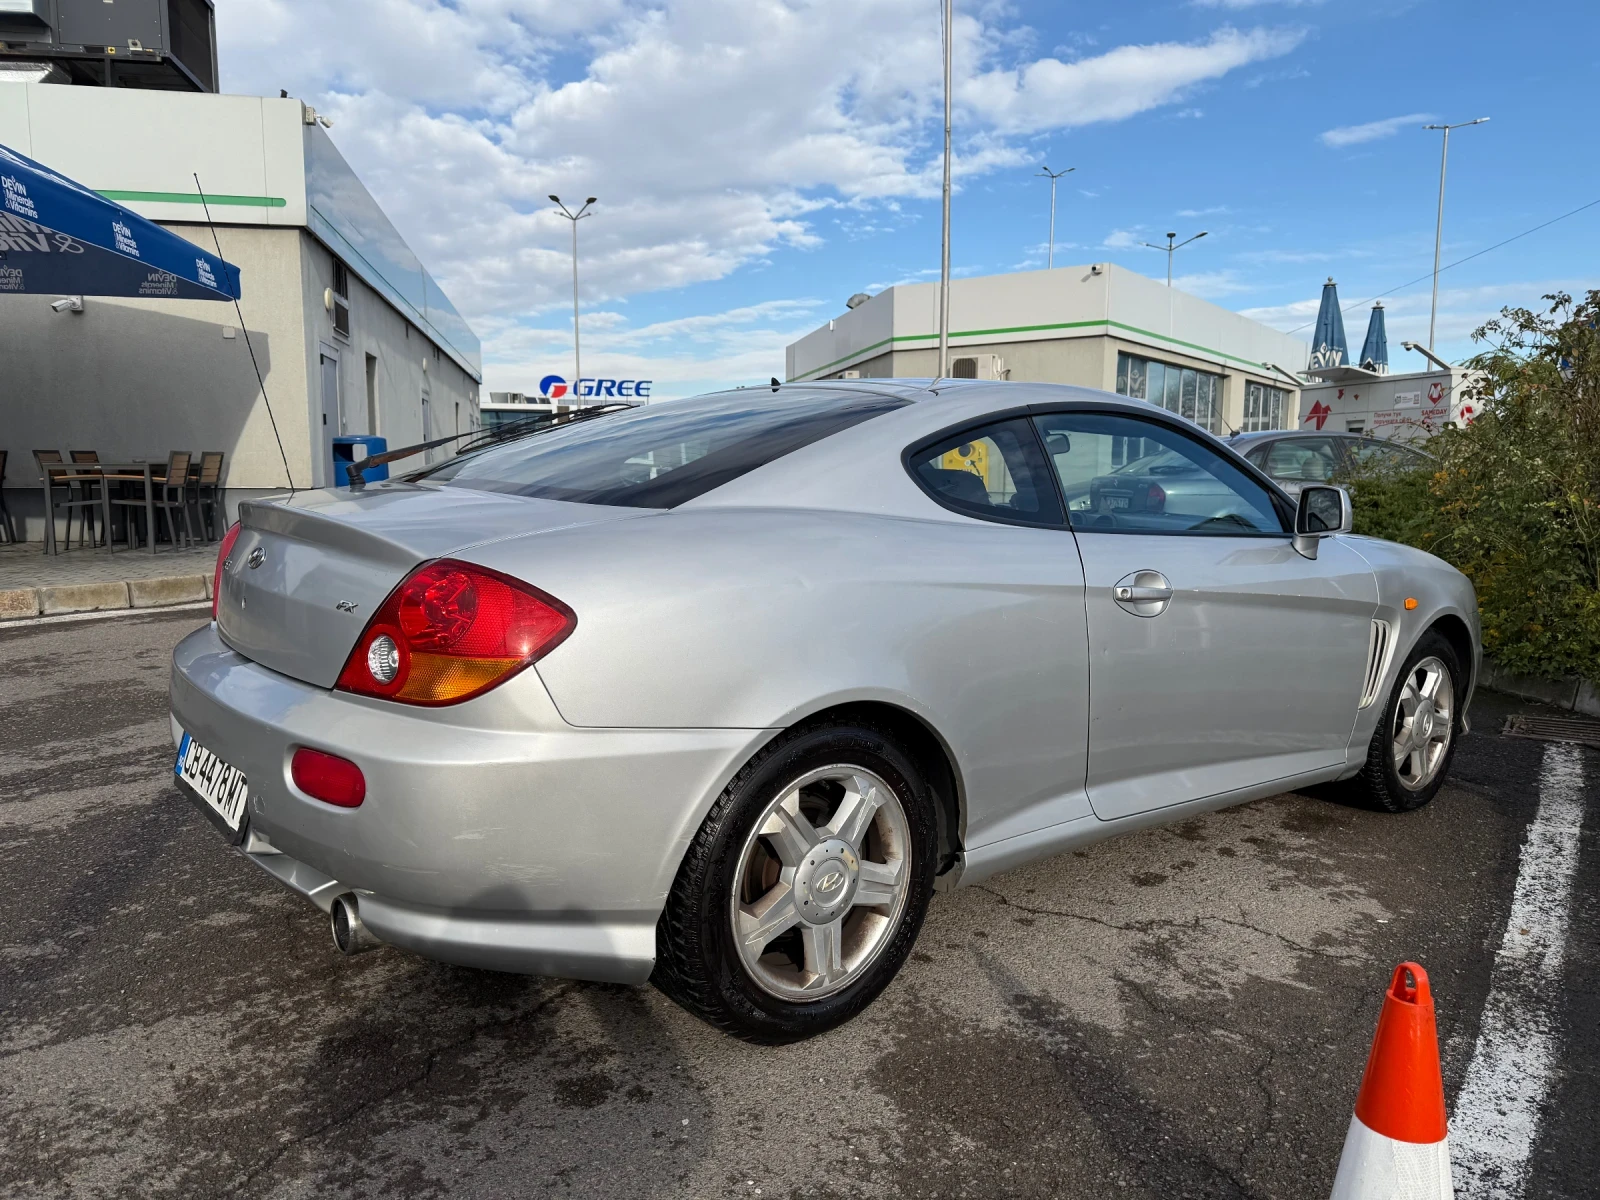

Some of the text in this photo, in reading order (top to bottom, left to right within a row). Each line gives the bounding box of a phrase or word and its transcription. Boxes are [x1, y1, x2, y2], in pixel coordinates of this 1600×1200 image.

[1, 175, 27, 196] DEVIN
[6, 189, 35, 209] Minerals
[112, 221, 132, 238] DEVIN
[116, 232, 137, 248] Minerals
[573, 378, 653, 397] GREE
[1421, 408, 1448, 416] SAMEDAY
[336, 599, 359, 614] FX
